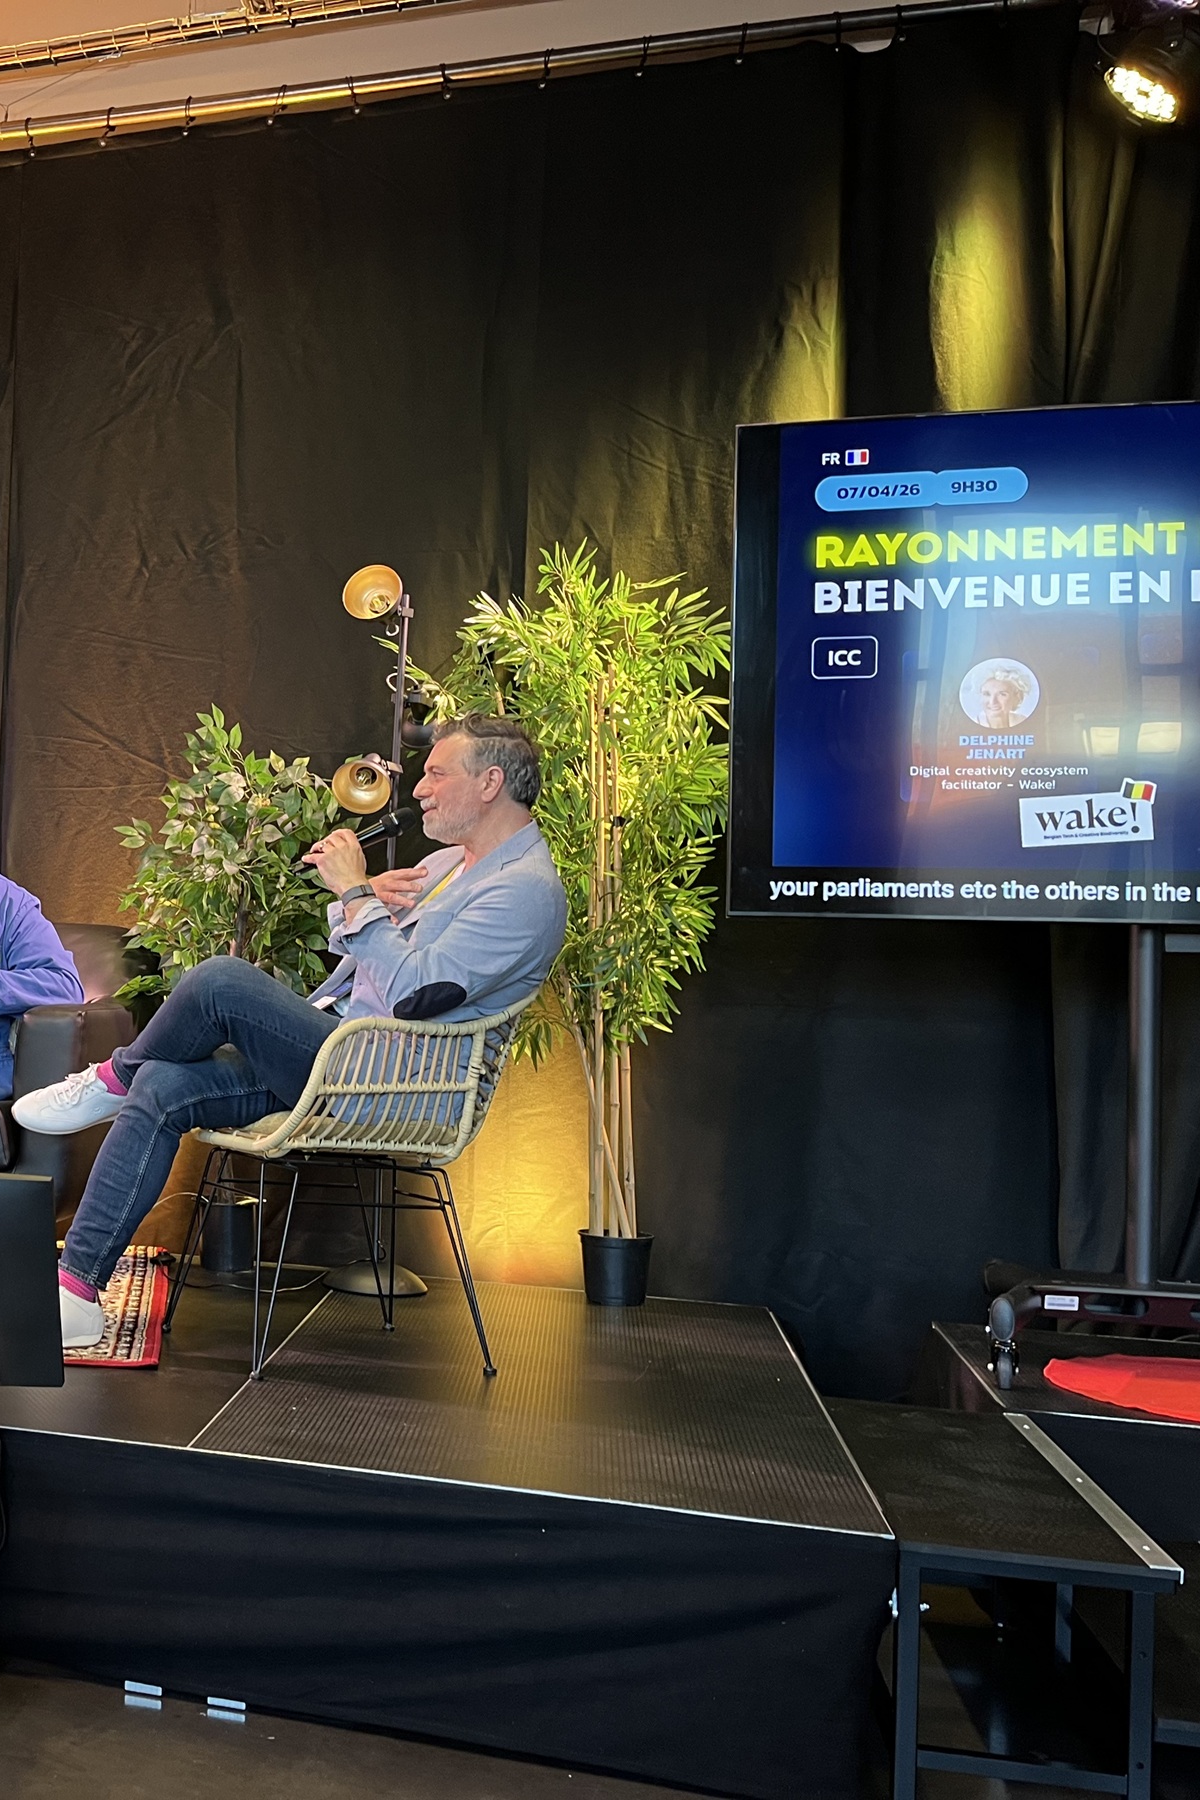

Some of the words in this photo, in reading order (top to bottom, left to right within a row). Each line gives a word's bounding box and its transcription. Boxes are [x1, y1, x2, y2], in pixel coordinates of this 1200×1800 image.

[822, 453, 840, 465] FR
[837, 484, 920, 499] 07/04/26
[951, 480, 998, 493] 9H30
[816, 522, 1185, 568] RAYONNEMENT
[814, 573, 1090, 614] BIENVENUE
[1109, 570, 1170, 604] EN
[828, 649, 861, 666] ICC
[958, 734, 1034, 746] DELPHINE
[966, 748, 1026, 760] JENART
[909, 765, 950, 778] Digital
[955, 765, 1016, 778] creativity
[1021, 766, 1089, 778] ecosystem
[941, 779, 1002, 790] facilitator
[1019, 779, 1056, 790] Wake!
[1035, 798, 1140, 834] wake!
[769, 880, 818, 900] your
[822, 878, 954, 901] parliaments
[960, 881, 997, 899] etc
[1001, 880, 1039, 900] the
[1045, 881, 1119, 901] others
[1125, 881, 1147, 901] in
[1152, 882, 1191, 902] the
